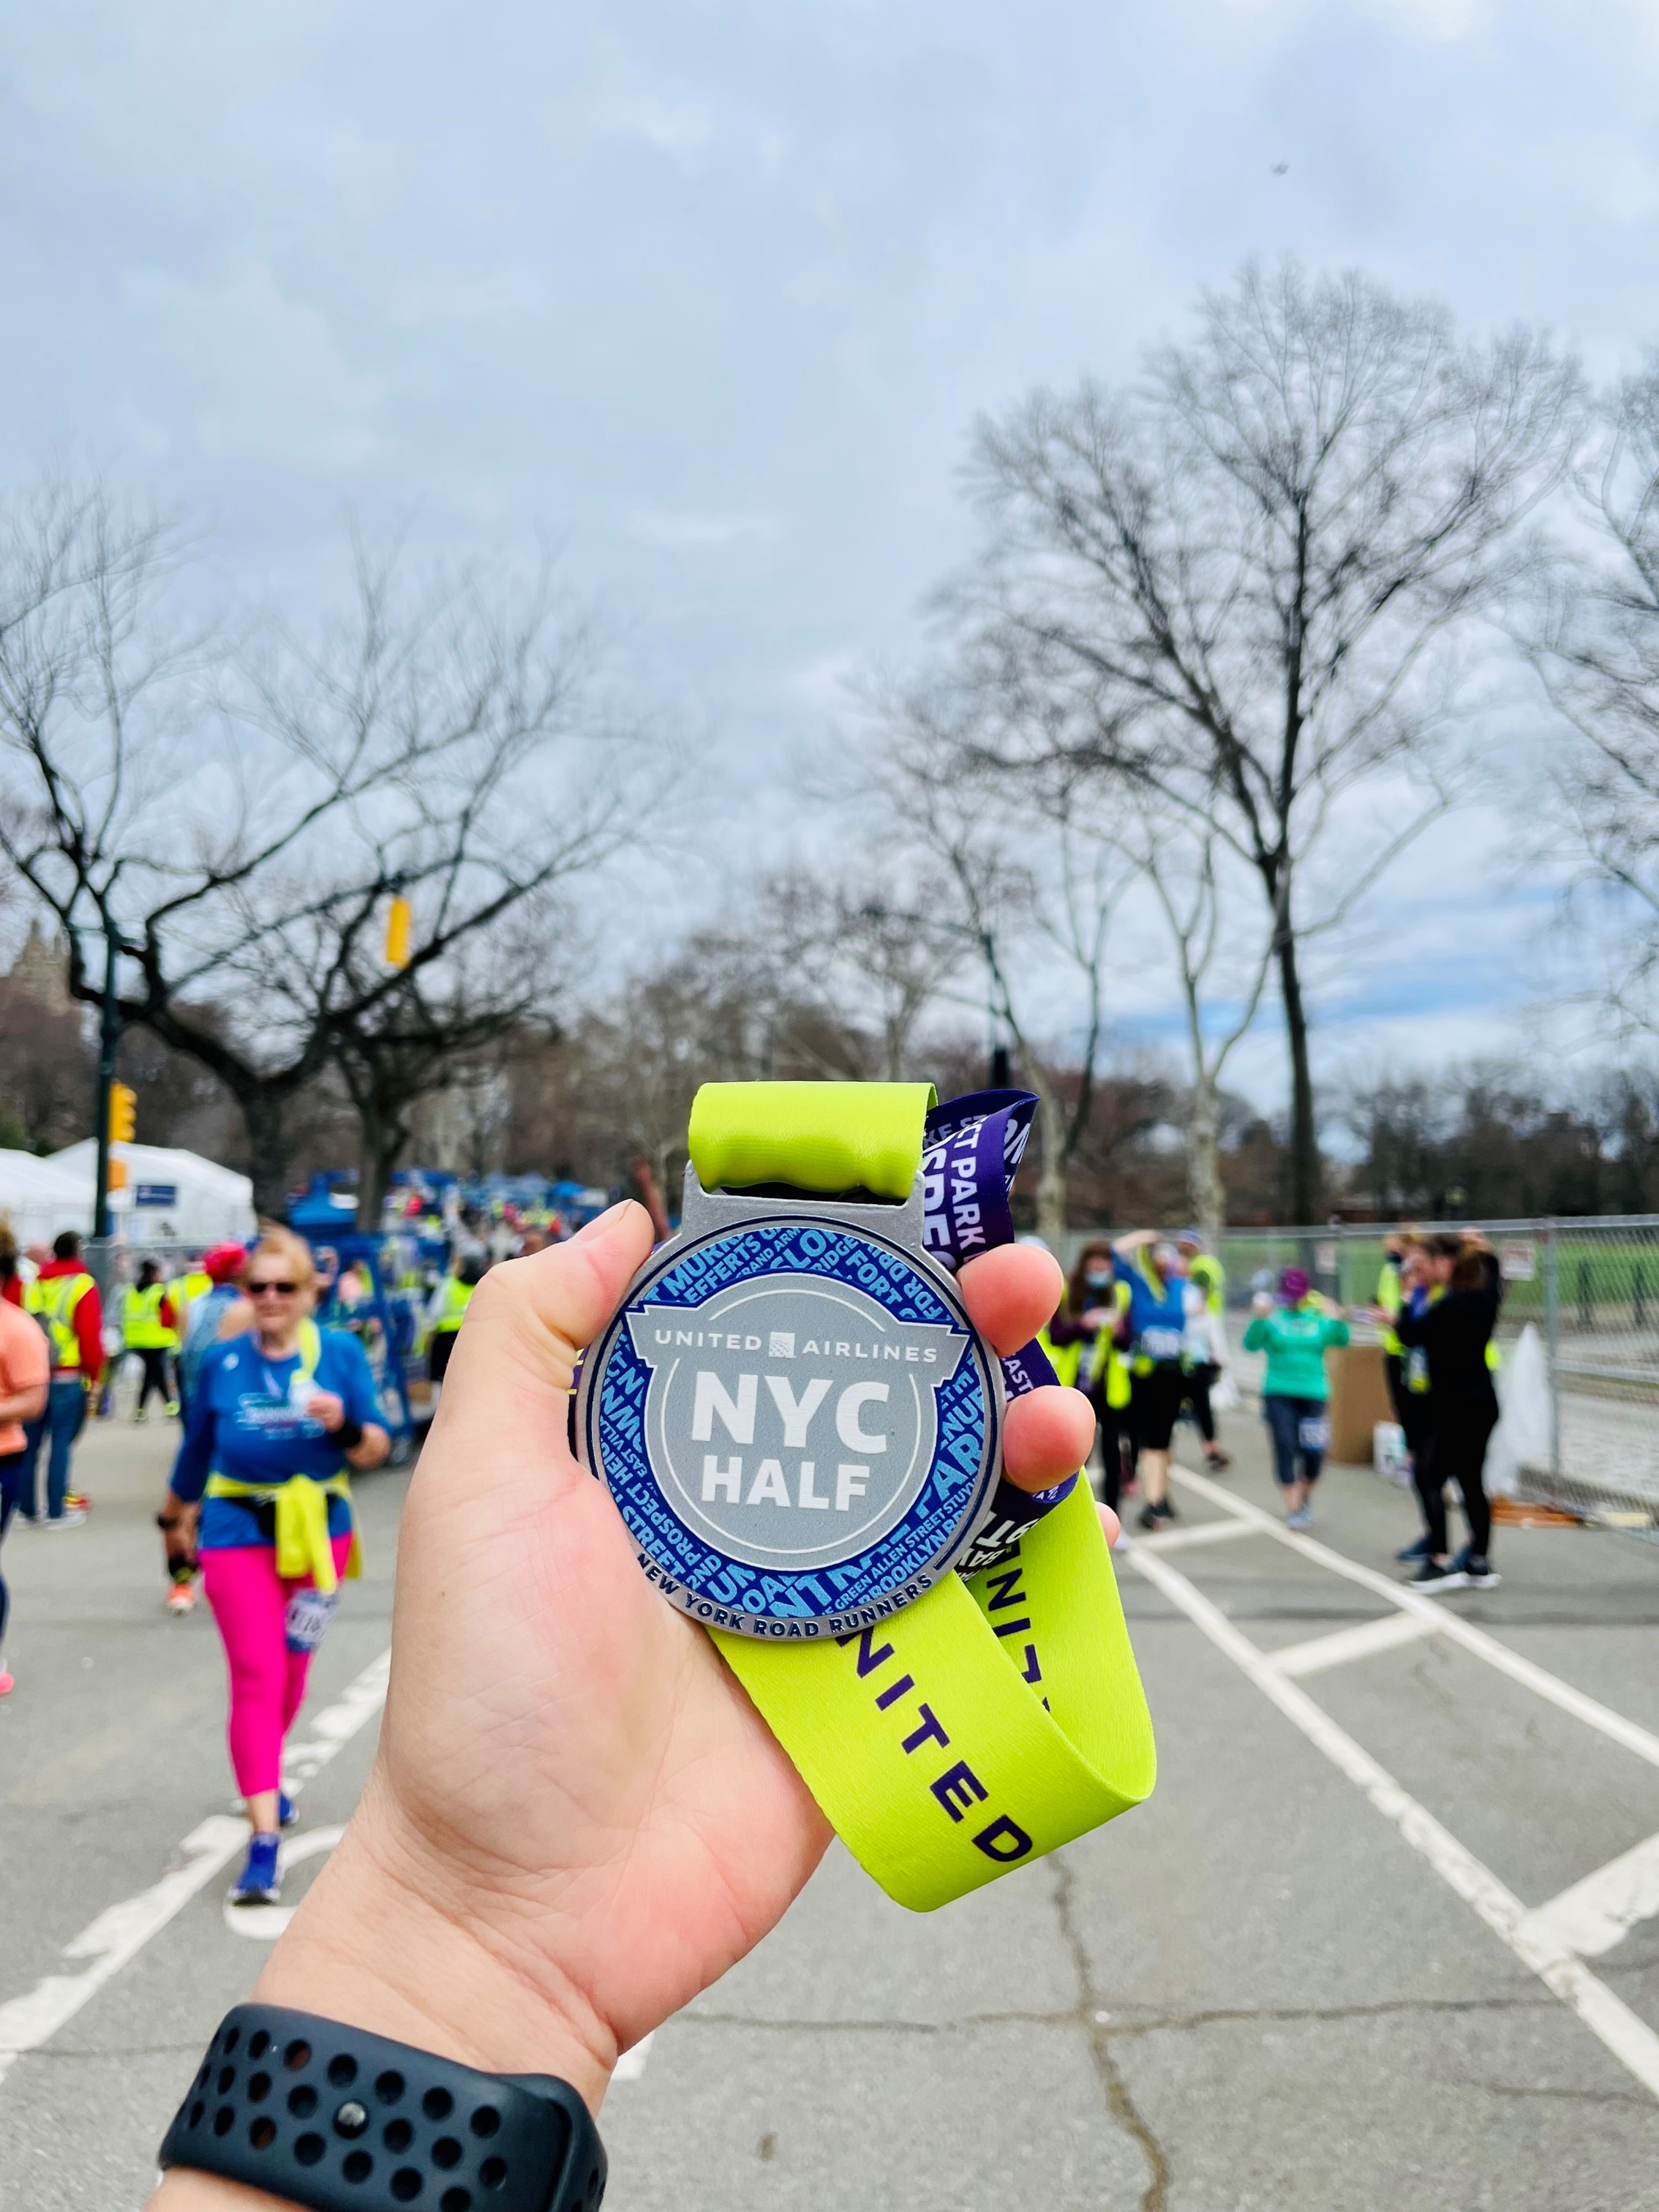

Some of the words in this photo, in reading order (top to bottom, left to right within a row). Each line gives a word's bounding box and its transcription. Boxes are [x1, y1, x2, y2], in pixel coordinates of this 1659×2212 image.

[951, 1156, 986, 1249] PARK
[684, 1235, 761, 1304] EFFERTS
[846, 1249, 903, 1305] FORT
[903, 1276, 944, 1320] FDR
[655, 1329, 762, 1351] UNITED
[802, 1339, 937, 1363] AIRLINES
[1001, 1355, 1034, 1392] AST
[691, 1371, 891, 1455] NYC
[600, 1438, 634, 1486] HEIG
[621, 1448, 648, 1478] EAST
[701, 1456, 870, 1512] HALF
[622, 1505, 686, 1577] STREET
[626, 1483, 702, 1567] PROSPECT
[686, 1554, 722, 1590] 2ND
[835, 1575, 873, 1611] GREEN
[872, 1543, 908, 1579] ALLEN
[905, 1508, 947, 1549] STREET
[858, 1530, 947, 1604] BROOKLYN
[637, 1551, 680, 1595] NEW
[685, 1591, 746, 1630] YORK
[753, 1618, 819, 1637] ROAD
[829, 1573, 933, 1633] RUNNERS
